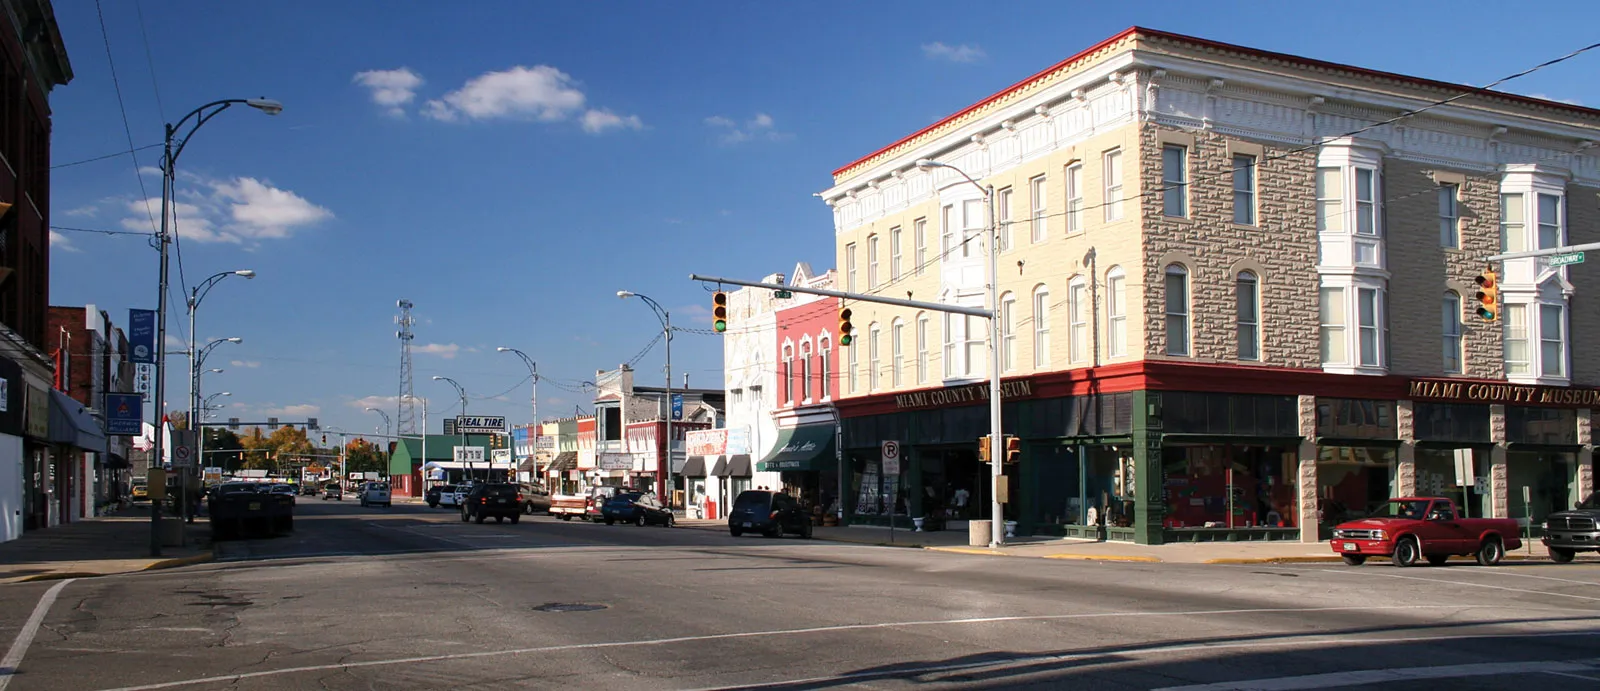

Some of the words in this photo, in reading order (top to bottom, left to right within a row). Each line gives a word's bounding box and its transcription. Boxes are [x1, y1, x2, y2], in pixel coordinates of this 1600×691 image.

[1551, 255, 1578, 265] BROADWAY
[896, 391, 928, 408] MIAMI
[931, 386, 974, 405] COUNTY
[979, 380, 1032, 400] MSEUM
[1409, 381, 1462, 398] MIAMI
[1468, 384, 1536, 402] COUNTY
[484, 418, 504, 426] TIRE
